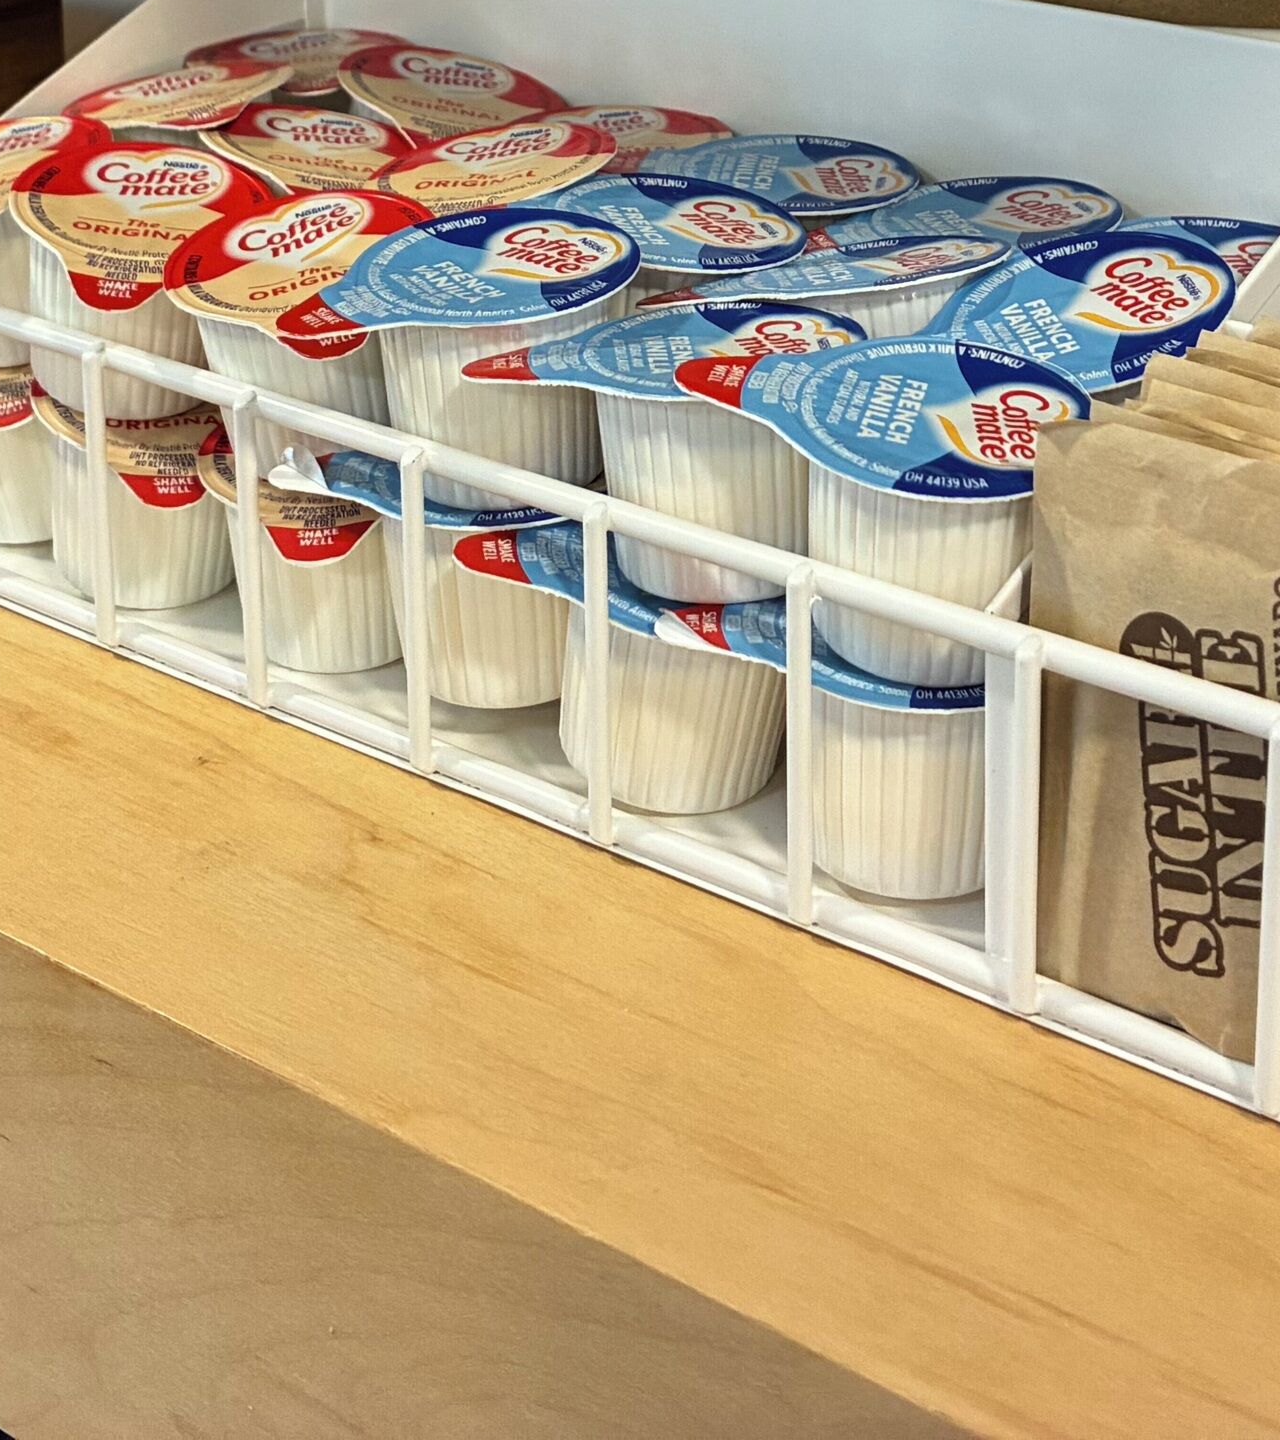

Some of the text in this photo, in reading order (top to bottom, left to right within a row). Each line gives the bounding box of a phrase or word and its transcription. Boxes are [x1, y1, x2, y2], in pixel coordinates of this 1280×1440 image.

[402, 57, 496, 80] Coffee
[423, 74, 499, 90] mate
[391, 95, 504, 121] ORIGINAL
[266, 117, 366, 136] Coffee
[293, 131, 371, 145] mate
[445, 131, 551, 156] Coffee
[464, 141, 550, 163] mate
[97, 162, 210, 184] Coffee
[268, 153, 376, 174] ORIGINA
[414, 170, 539, 191] ORIGINAL
[815, 166, 849, 197] mate
[835, 158, 875, 193] Coffee
[120, 180, 211, 197] mate
[996, 205, 1065, 228] mate
[1005, 190, 1083, 221] Coffee
[72, 221, 191, 241] ORIGINA
[127, 218, 162, 229] The
[238, 204, 349, 252] Coffee
[621, 206, 670, 246] FRENCH
[679, 212, 745, 245] mate
[693, 200, 768, 242] Coffee
[270, 214, 355, 259] mate
[504, 226, 600, 265] Coffee
[496, 247, 581, 274] mate
[1007, 240, 1099, 279] MILK A CONTAINS:
[297, 264, 332, 279] The
[431, 260, 507, 298] FRENCH
[96, 280, 138, 291] SHAKE
[98, 289, 133, 299] WELL
[248, 268, 347, 302] ORIGIN
[410, 263, 487, 304] VANILLA
[1104, 257, 1190, 312] Coffee
[1090, 280, 1165, 325] mate
[755, 320, 811, 354] Coffe
[999, 302, 1056, 361] VANILLA
[1023, 298, 1081, 355] FRENCH
[319, 333, 357, 348] WELL
[734, 337, 774, 356] ma
[928, 344, 956, 354] MILK
[958, 346, 966, 356] A
[708, 364, 724, 382] WELL
[723, 364, 746, 388] SHAKE
[856, 374, 904, 439] VANILLA
[885, 378, 929, 445] FRENCH
[105, 415, 218, 431] ORIGINA
[971, 403, 1009, 465] mate
[999, 390, 1050, 460] Coffee
[152, 476, 194, 486] SHAKE
[156, 484, 191, 495] WELL
[904, 471, 989, 489] OH 44139 USA
[296, 528, 340, 538] SHAKE
[303, 518, 336, 528] NEEDED
[299, 536, 334, 547] WELL
[483, 540, 497, 561] WELL
[498, 538, 516, 563] SHAKE
[915, 689, 933, 701] OH
[1210, 826, 1268, 927] IN
